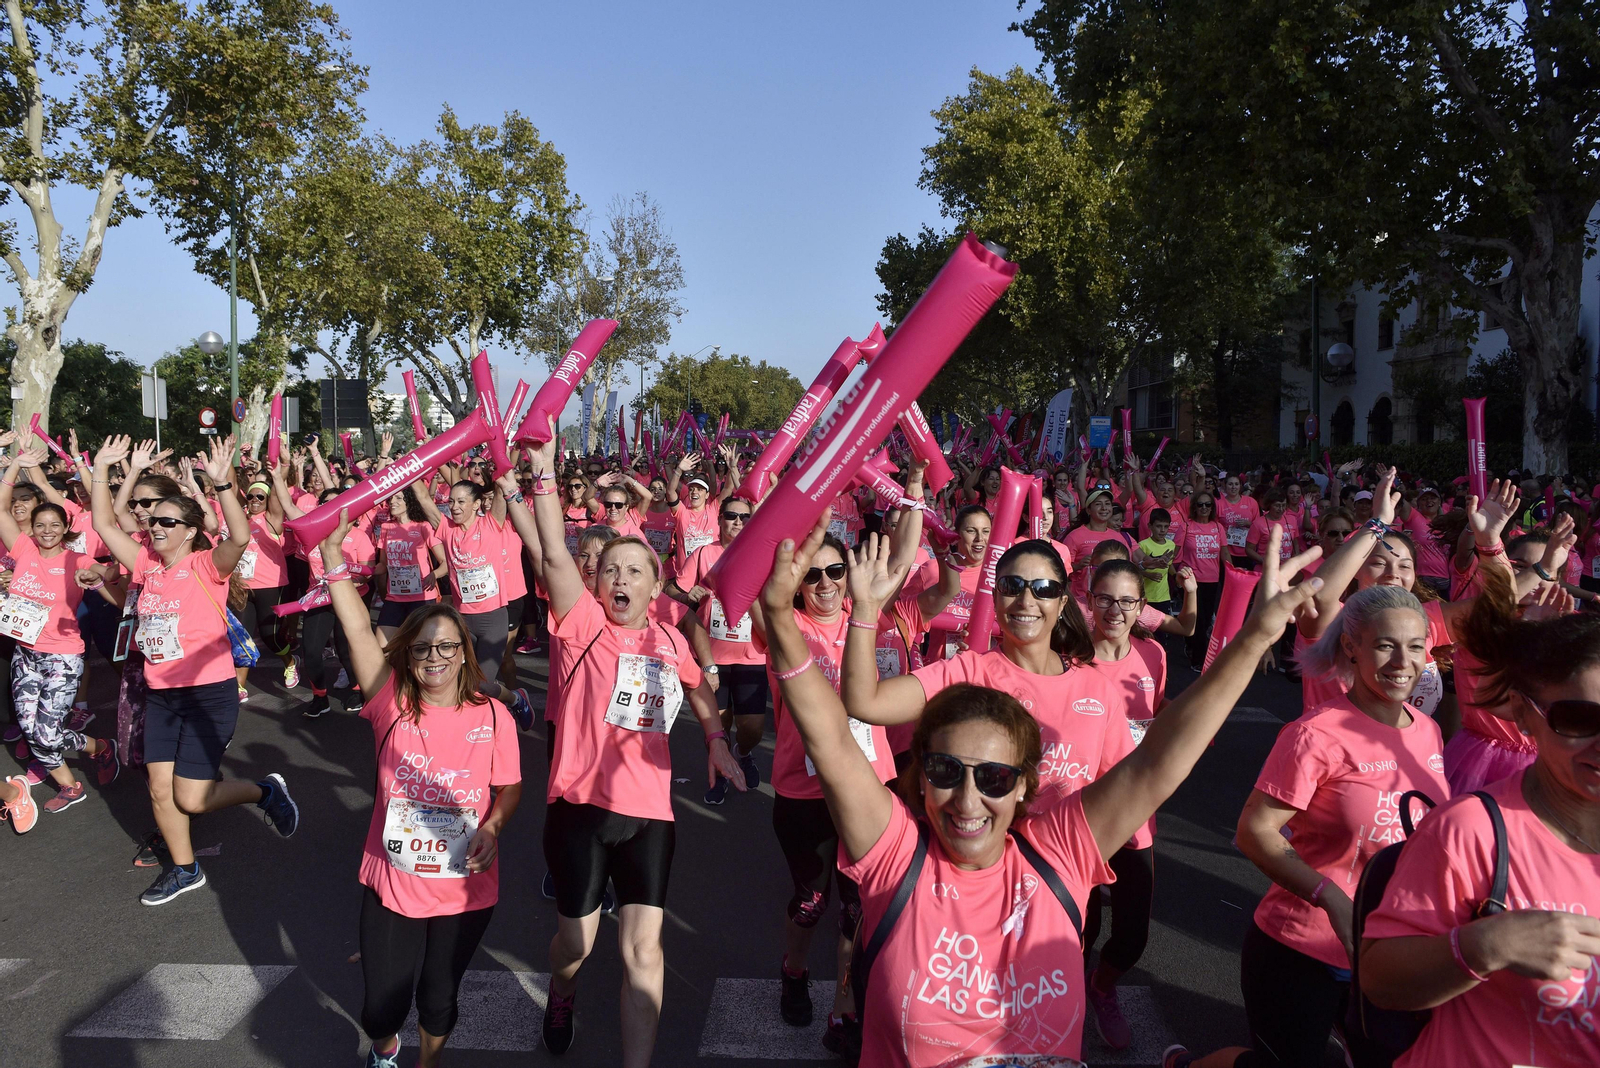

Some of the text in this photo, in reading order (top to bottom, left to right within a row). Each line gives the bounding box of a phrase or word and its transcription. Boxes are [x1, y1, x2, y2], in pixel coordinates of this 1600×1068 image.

[554, 350, 586, 386] Ladival
[782, 392, 821, 439] Ladival
[911, 400, 930, 435] adival
[1056, 409, 1067, 446] ZURICH
[810, 391, 900, 502] Protección solar en profundidad
[368, 452, 424, 495] Ladival
[11, 581, 57, 601] LAS CHICAS
[469, 582, 487, 591] 016
[12, 615, 31, 628] 016
[146, 636, 164, 647] 016
[637, 692, 666, 708] 016
[1075, 703, 1104, 713] ASTURIANA
[400, 751, 434, 770] HOY
[1359, 760, 1398, 773] OYSHO
[395, 765, 457, 788] GANAN
[390, 780, 483, 804] LAS CHICAS
[1376, 790, 1407, 809] HO
[413, 814, 453, 824] ASTURIANA
[1368, 826, 1405, 844] LAS
[410, 838, 448, 853] 016
[416, 854, 437, 863] 8876
[928, 953, 1017, 996] GANAN
[917, 969, 1068, 1020] LAS CHICAS
[1536, 1006, 1595, 1034] LAS
